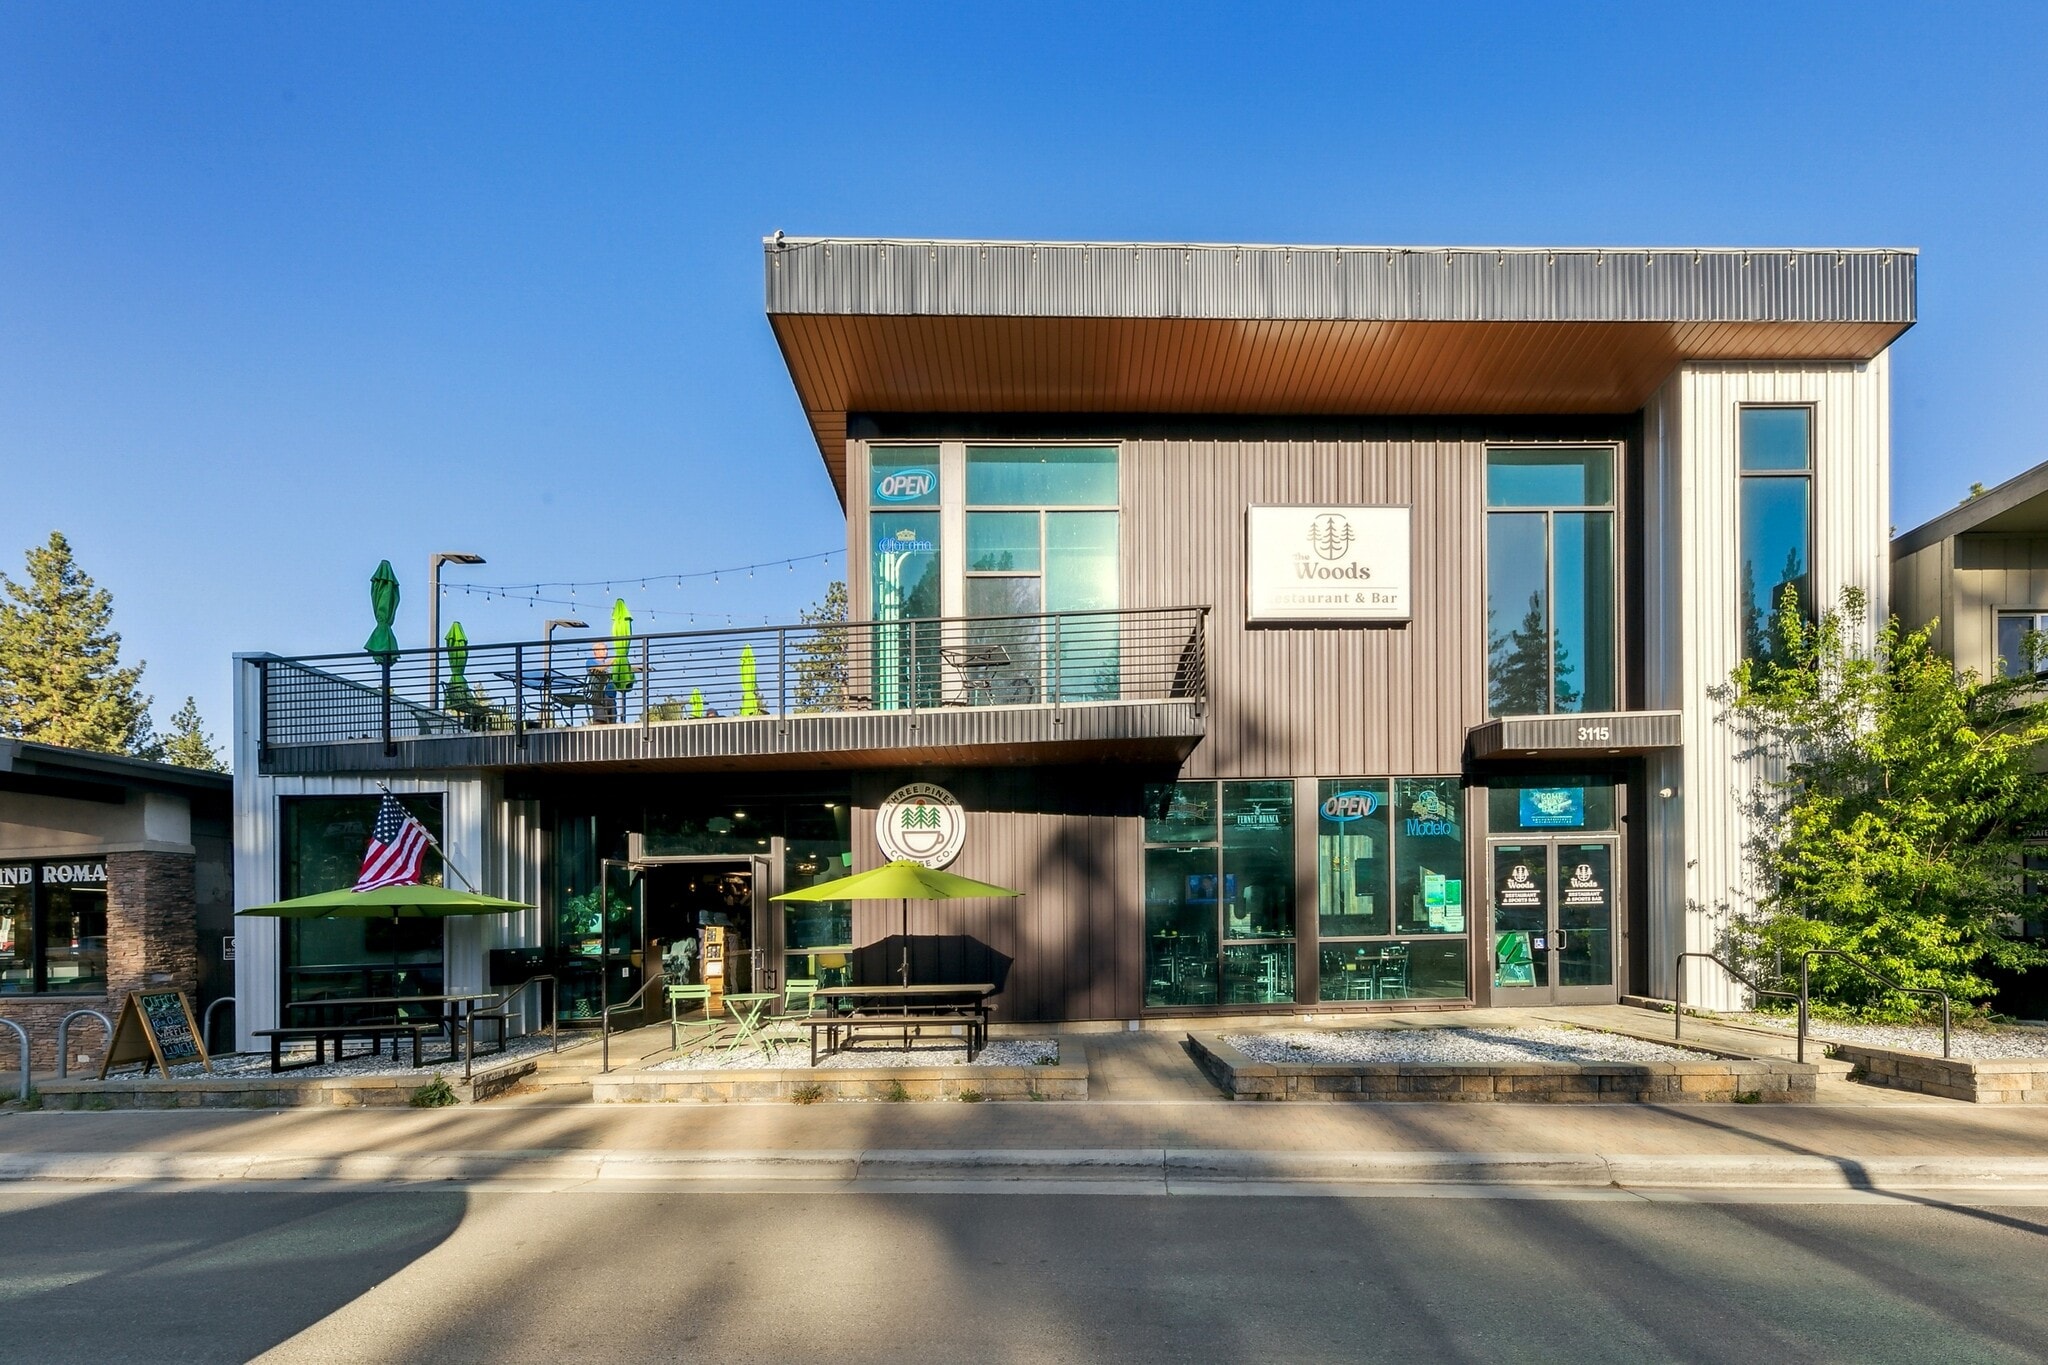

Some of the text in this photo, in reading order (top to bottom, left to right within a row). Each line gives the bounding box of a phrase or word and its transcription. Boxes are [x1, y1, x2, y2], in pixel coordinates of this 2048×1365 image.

[882, 475, 930, 495] OPEN
[879, 538, 932, 552] Corona
[1295, 562, 1371, 580] Woods
[1273, 593, 1398, 604] estaurant & Bar
[1578, 727, 1609, 741] 3115
[886, 786, 955, 808] THREE PINES
[1541, 792, 1563, 800] COME
[1326, 797, 1370, 816] OPEN
[1405, 818, 1451, 836] Modelo
[890, 850, 953, 868] COE CO.
[42, 864, 108, 883] ROMA
[1508, 881, 1535, 889] Woods
[1571, 880, 1598, 888] Woods
[163, 1041, 195, 1055] LUNCH
